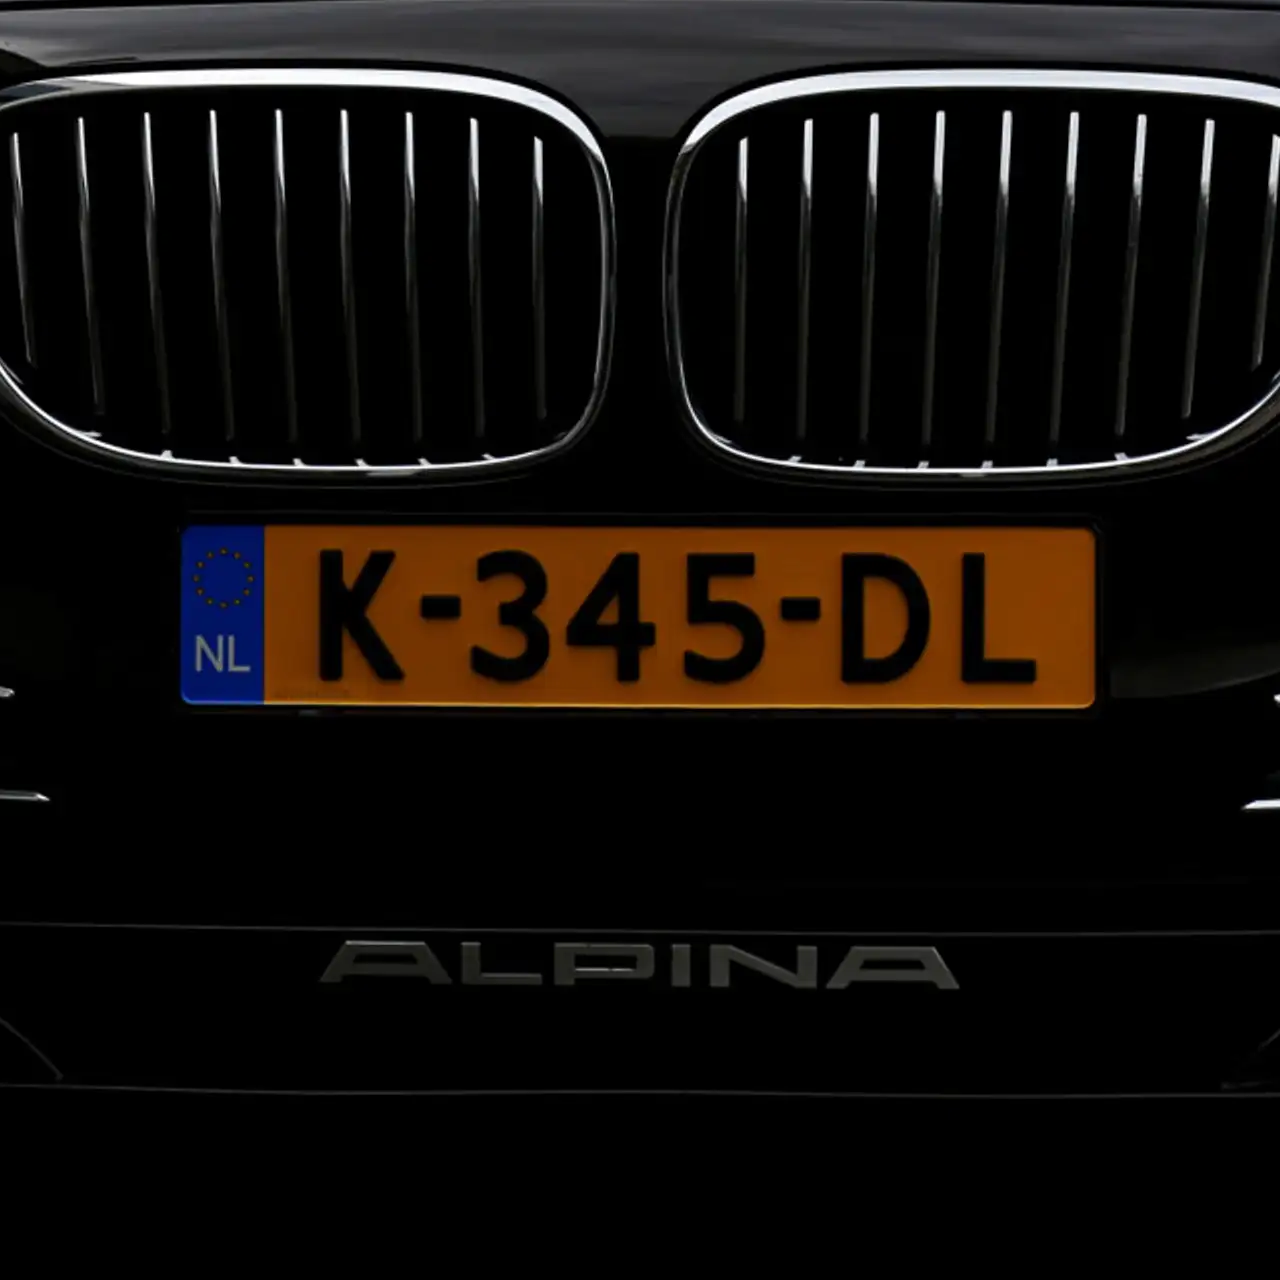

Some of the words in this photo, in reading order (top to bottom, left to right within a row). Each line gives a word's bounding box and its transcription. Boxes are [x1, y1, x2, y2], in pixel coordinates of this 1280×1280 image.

[319, 548, 1037, 684] K-345-DL
[195, 634, 251, 673] NL
[320, 940, 960, 990] ALPINA
